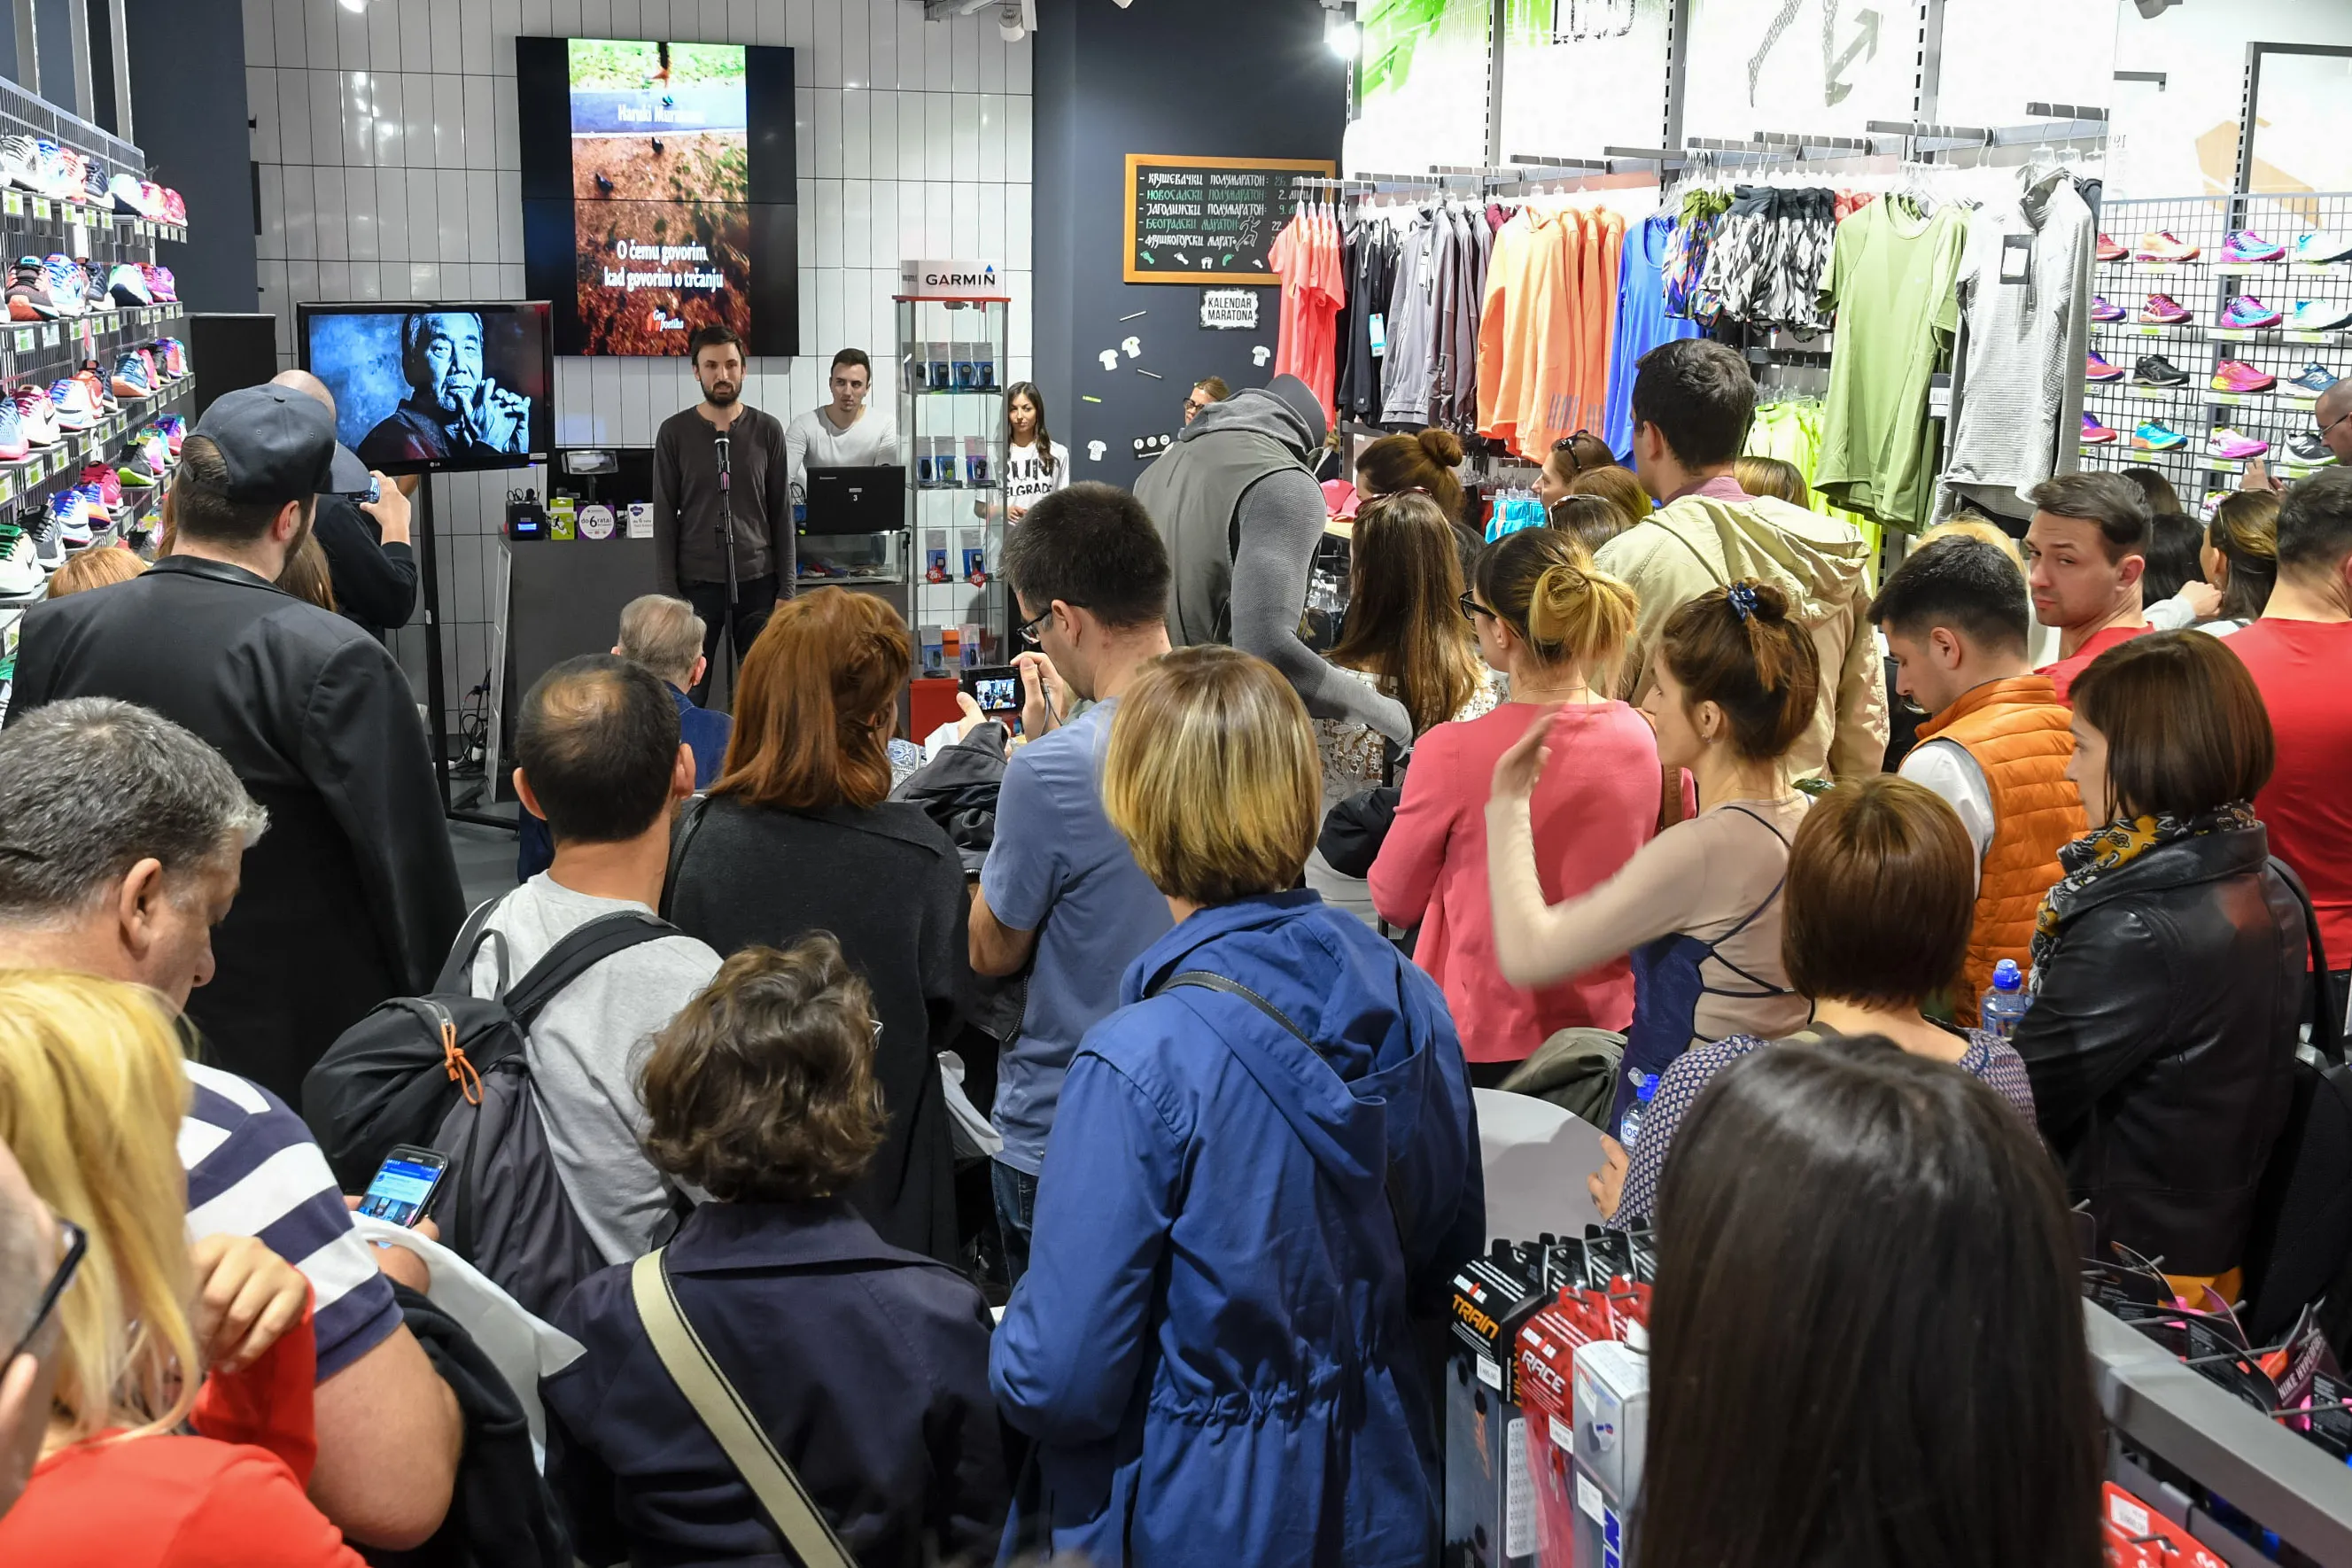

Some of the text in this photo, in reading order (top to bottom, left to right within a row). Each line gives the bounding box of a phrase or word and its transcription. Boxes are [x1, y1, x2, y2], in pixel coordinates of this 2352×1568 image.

[1148, 173, 1203, 188] КРУШЕВАЧКИ
[1147, 189, 1203, 201] НОВОСАДСКИ
[1145, 218, 1197, 233] БЕОГРАДСКИ
[617, 239, 627, 260] O
[629, 239, 660, 260] čemu
[604, 266, 724, 293] kad govorim o trčanju
[926, 274, 996, 286] GARMIN
[1207, 297, 1252, 309] KALENDAR
[1207, 309, 1254, 321] MARATONA
[589, 515, 598, 528] 6
[1452, 1293, 1500, 1340] TRAIN
[1521, 1349, 1566, 1393] RACE
